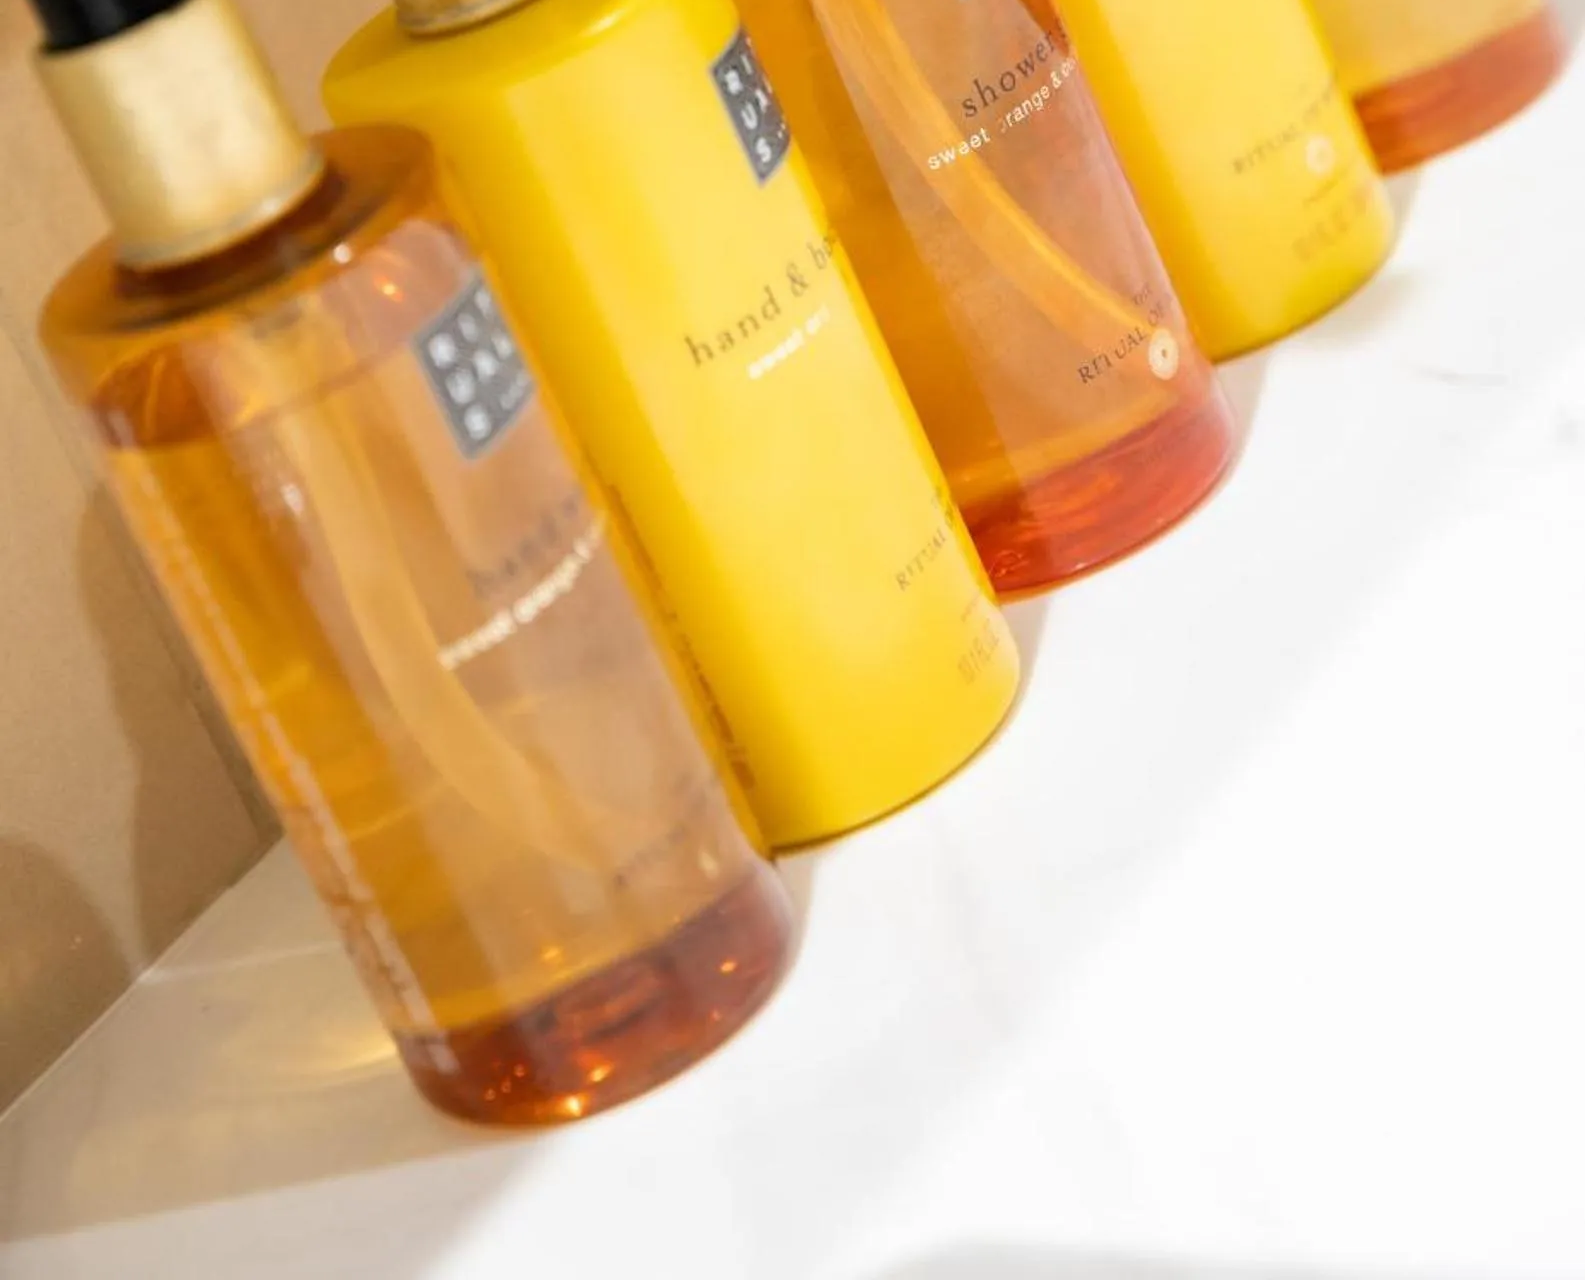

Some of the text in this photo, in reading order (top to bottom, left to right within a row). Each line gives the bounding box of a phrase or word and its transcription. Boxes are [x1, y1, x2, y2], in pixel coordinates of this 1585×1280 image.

[927, 127, 992, 171] sweet
[684, 283, 782, 369] hand
[785, 259, 809, 298] &
